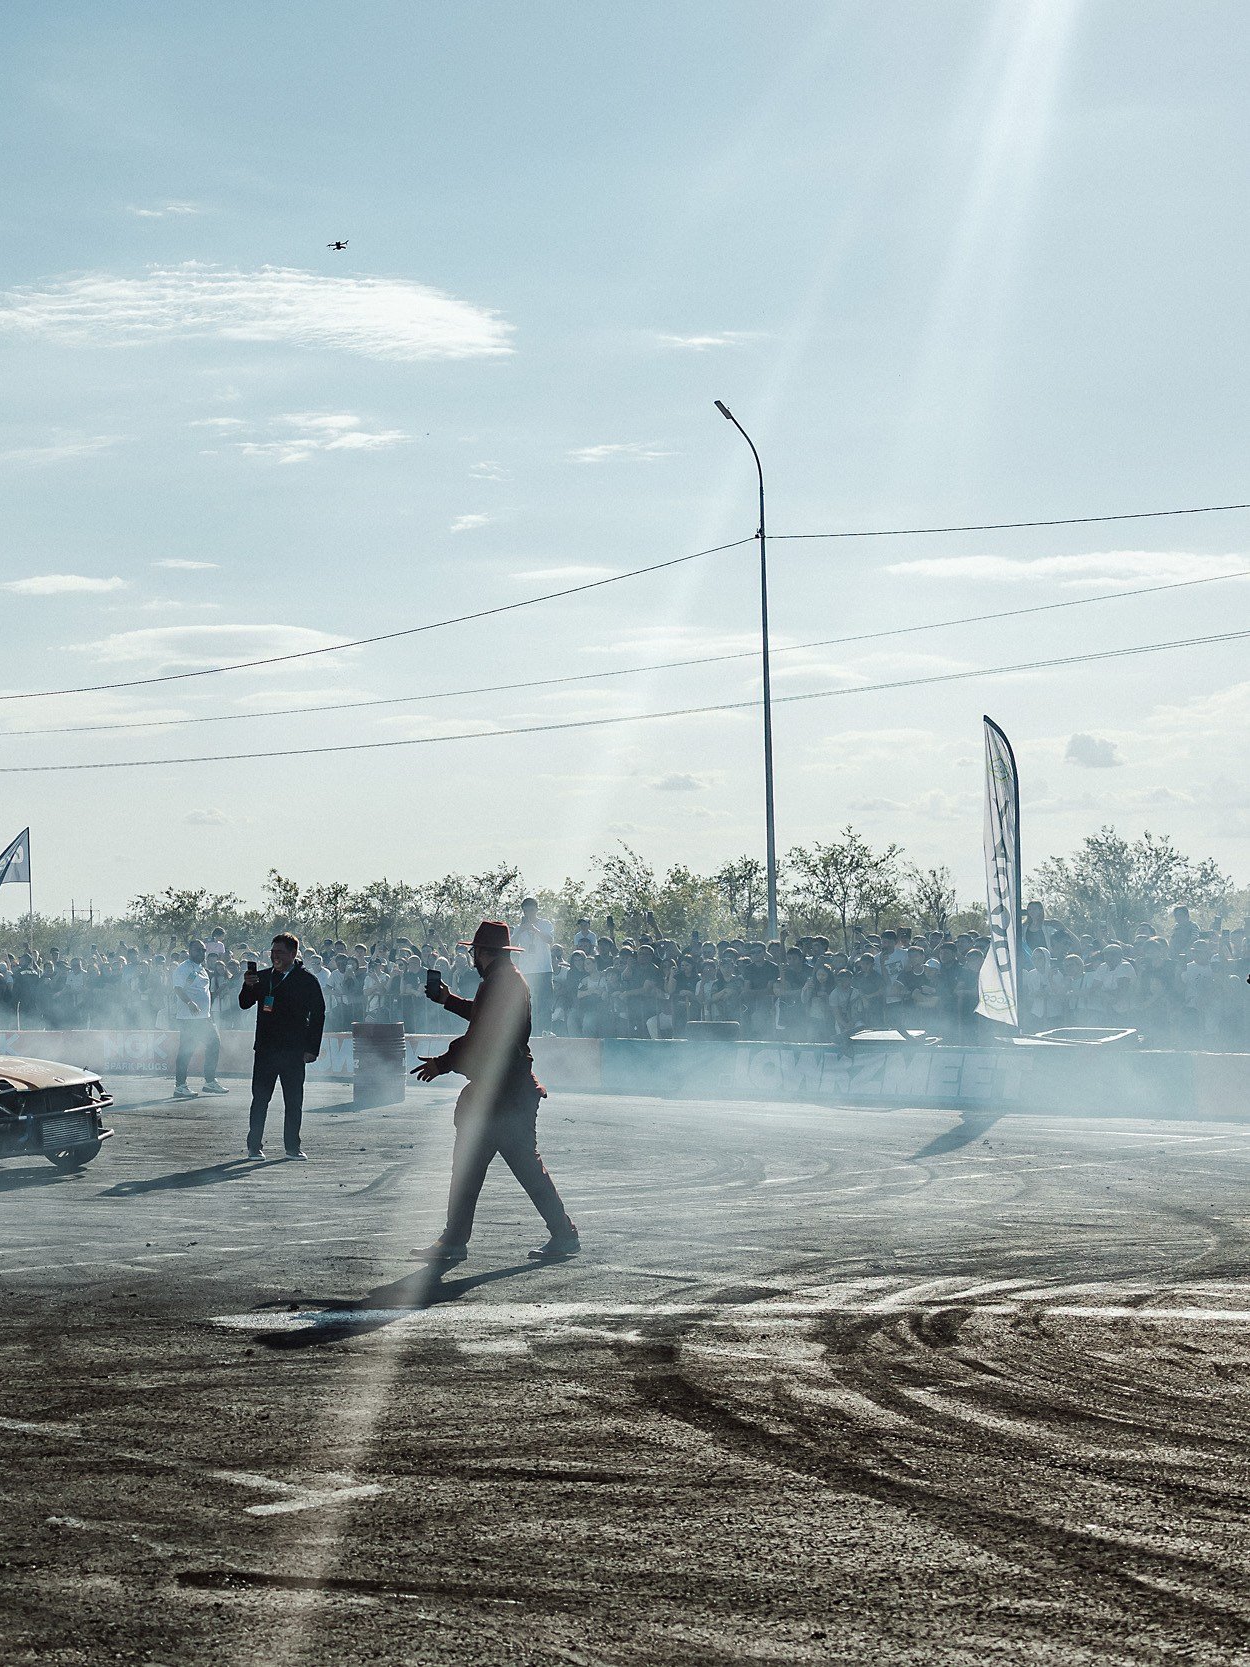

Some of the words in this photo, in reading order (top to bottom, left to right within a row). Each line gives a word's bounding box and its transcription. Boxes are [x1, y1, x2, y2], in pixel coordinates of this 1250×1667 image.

[104, 1032, 168, 1060] NGK
[104, 1062, 135, 1071] SPARK
[136, 1062, 168, 1071] PLUGS
